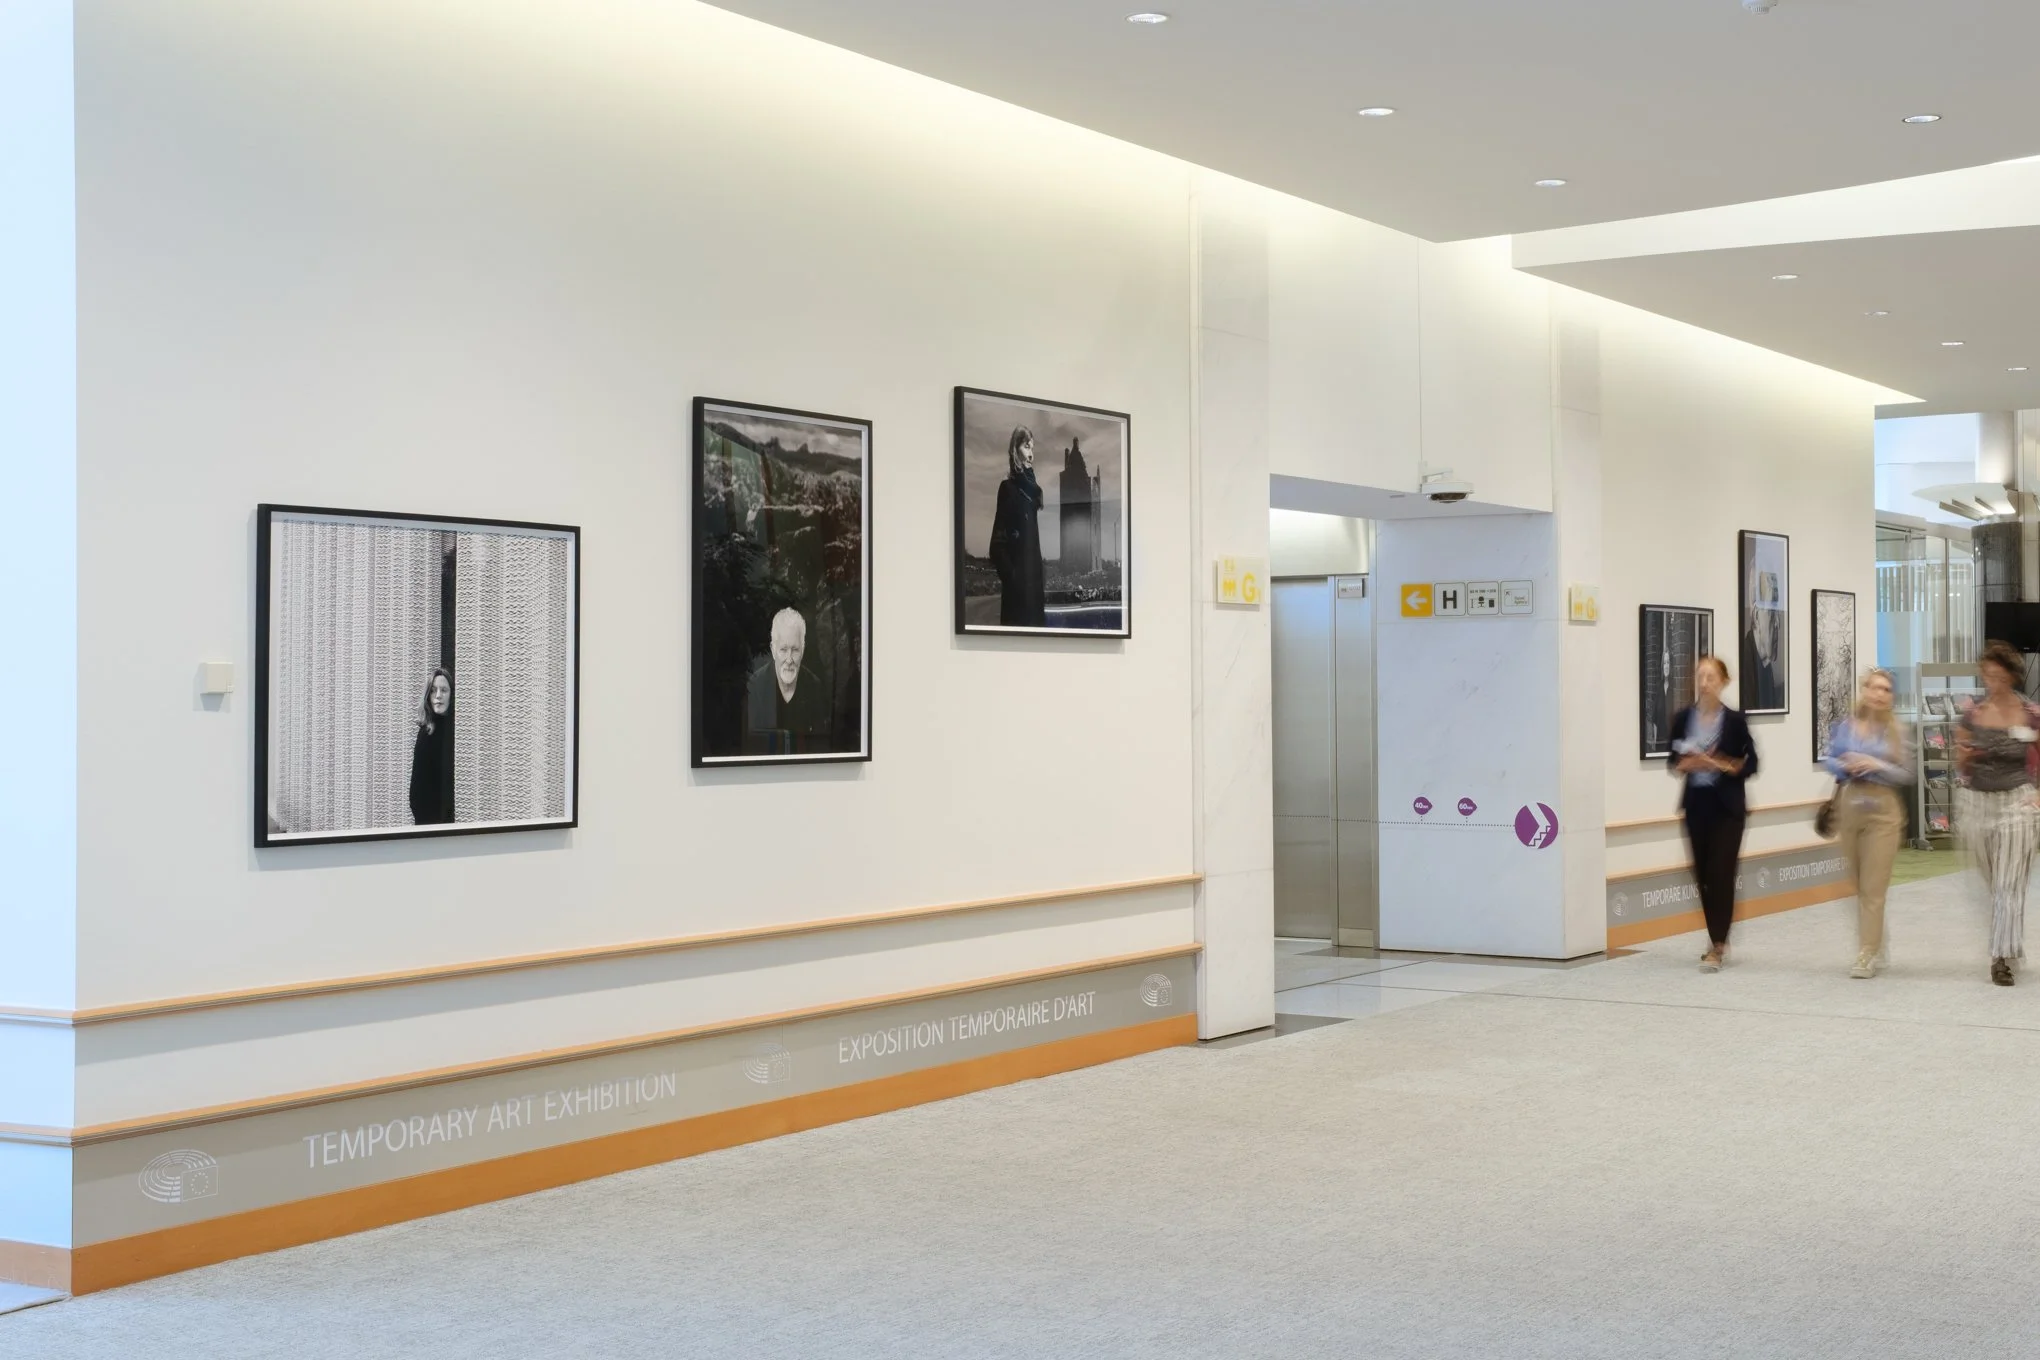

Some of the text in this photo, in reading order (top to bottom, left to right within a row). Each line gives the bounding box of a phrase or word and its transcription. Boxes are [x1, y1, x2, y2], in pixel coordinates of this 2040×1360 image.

[1442, 589, 1458, 610] H
[1779, 864, 1810, 882] EXPOSITION
[1810, 857, 1841, 876] TEMPORAIRE
[838, 991, 1097, 1064] EXPOSITION TEMPORAIRE D'ART
[302, 1071, 678, 1168] TEMPORARY ART EXHIBITION
